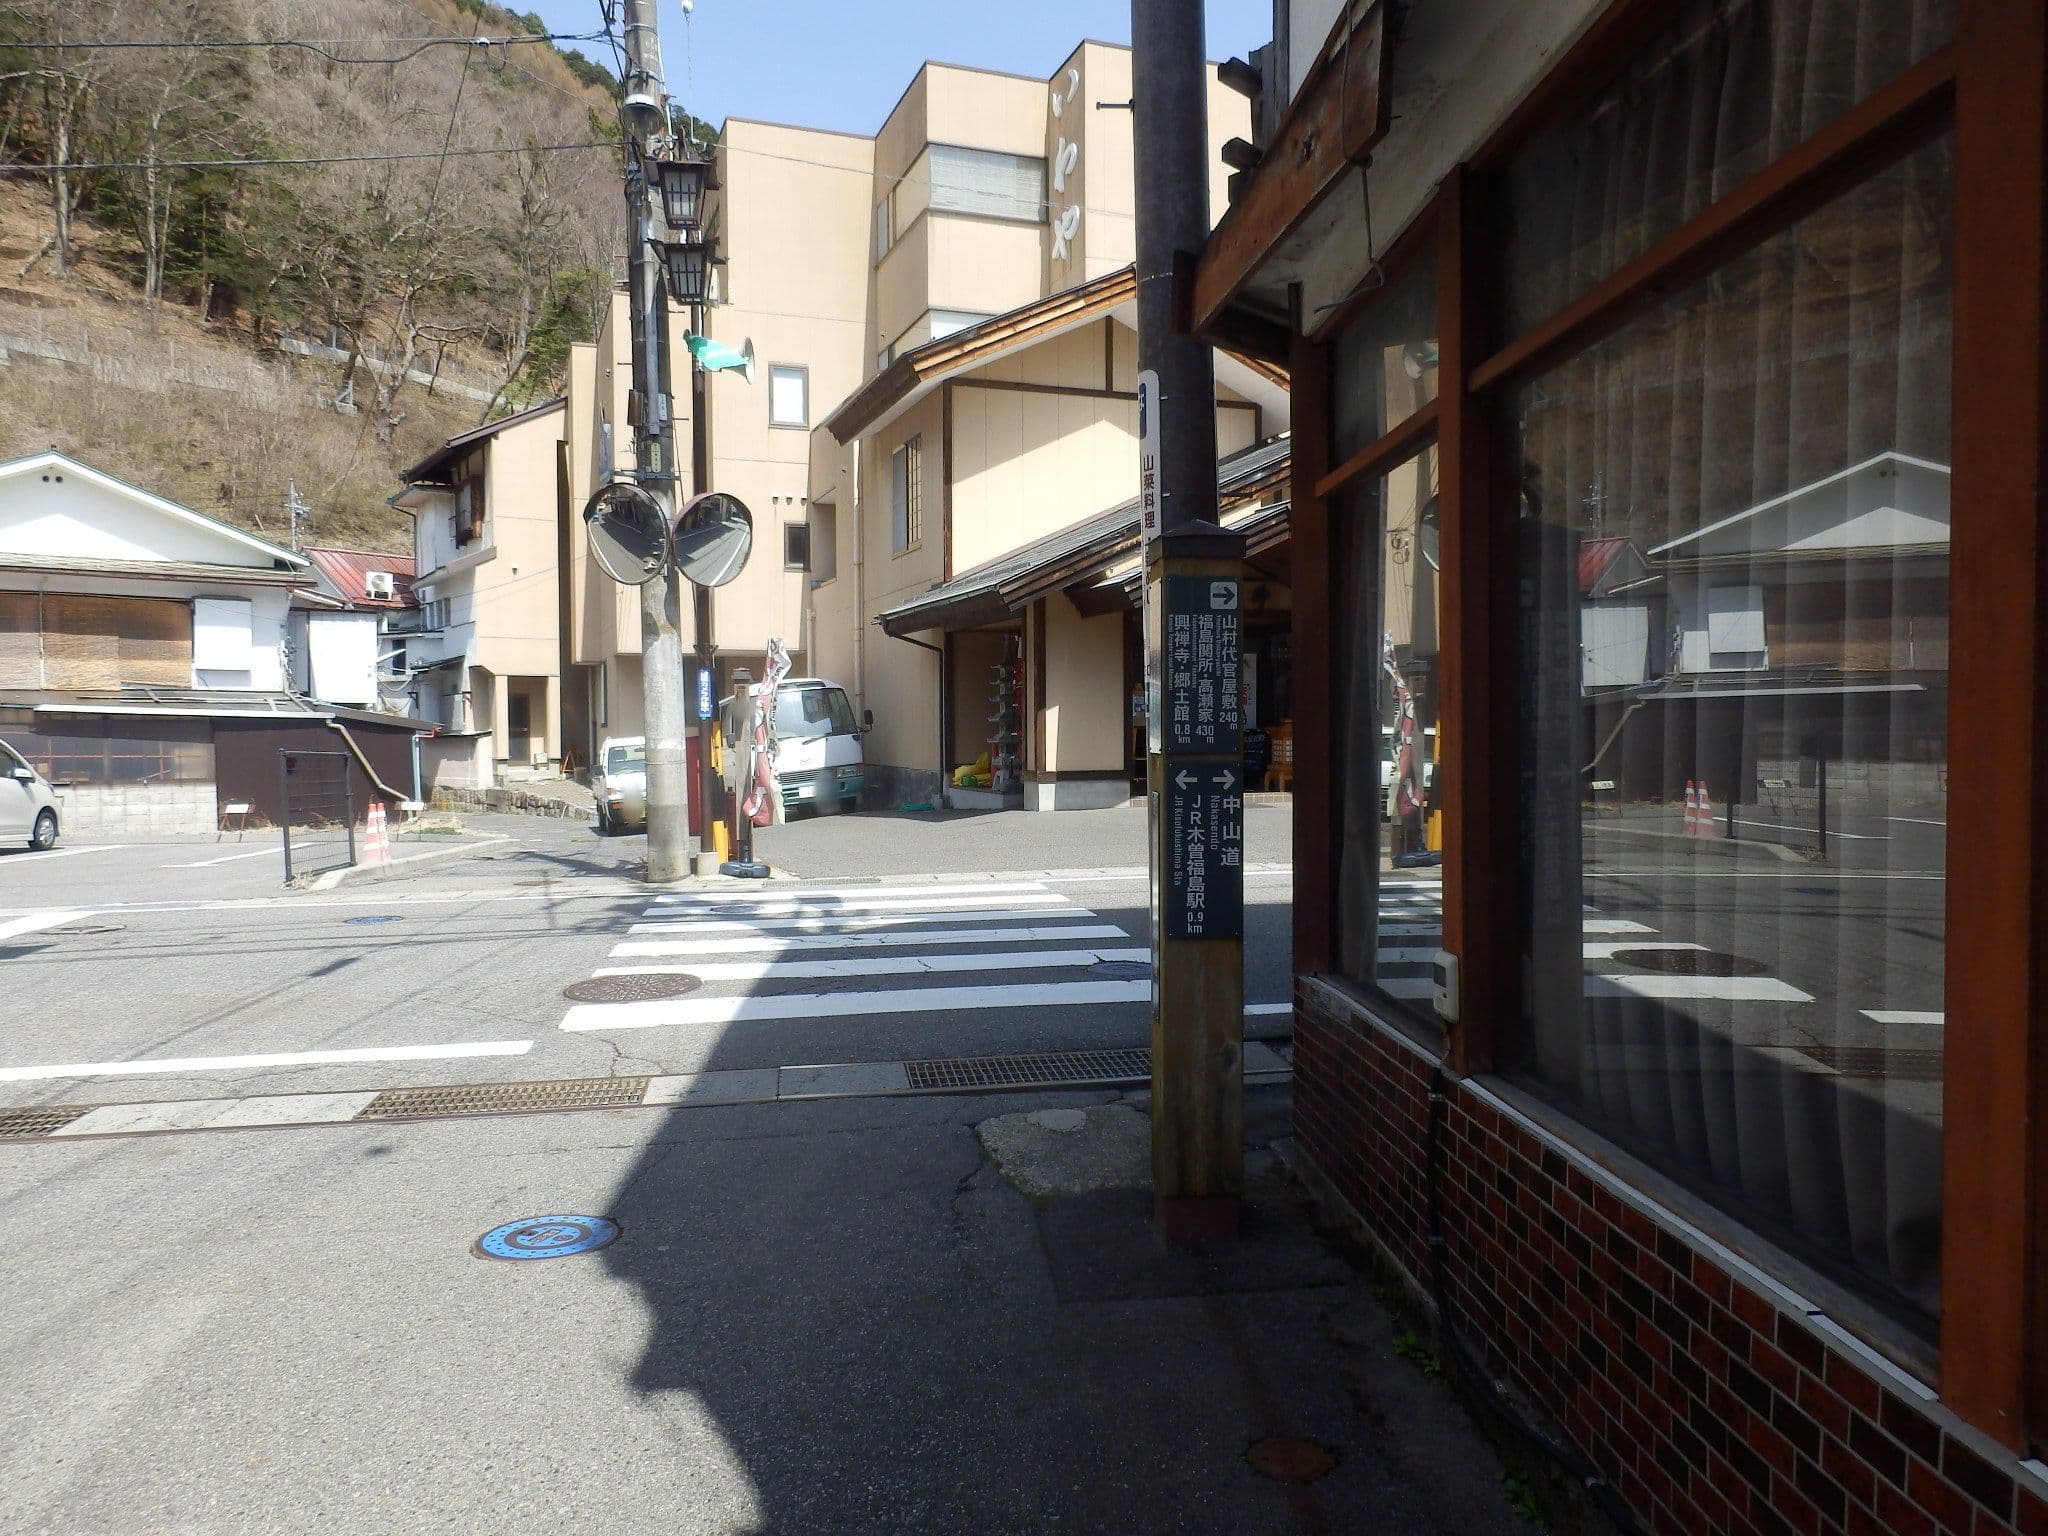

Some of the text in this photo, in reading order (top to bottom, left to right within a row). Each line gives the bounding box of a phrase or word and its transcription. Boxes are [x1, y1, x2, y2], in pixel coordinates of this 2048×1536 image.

[1174, 614, 1190, 722] 興禅寺・郷土館
[1198, 614, 1214, 722] 福島関所・高瀬家
[1221, 614, 1237, 709] 山村代官屋敷
[1174, 724, 1190, 735] 0.8
[1196, 725, 1214, 736] 430
[1219, 712, 1237, 723] 240
[1174, 795, 1184, 807] JR
[1210, 795, 1220, 850] Nakasendo
[1186, 794, 1205, 909] JR木曽福島駅
[1220, 795, 1241, 866] 中山道
[1187, 912, 1204, 934] 0.9 km
